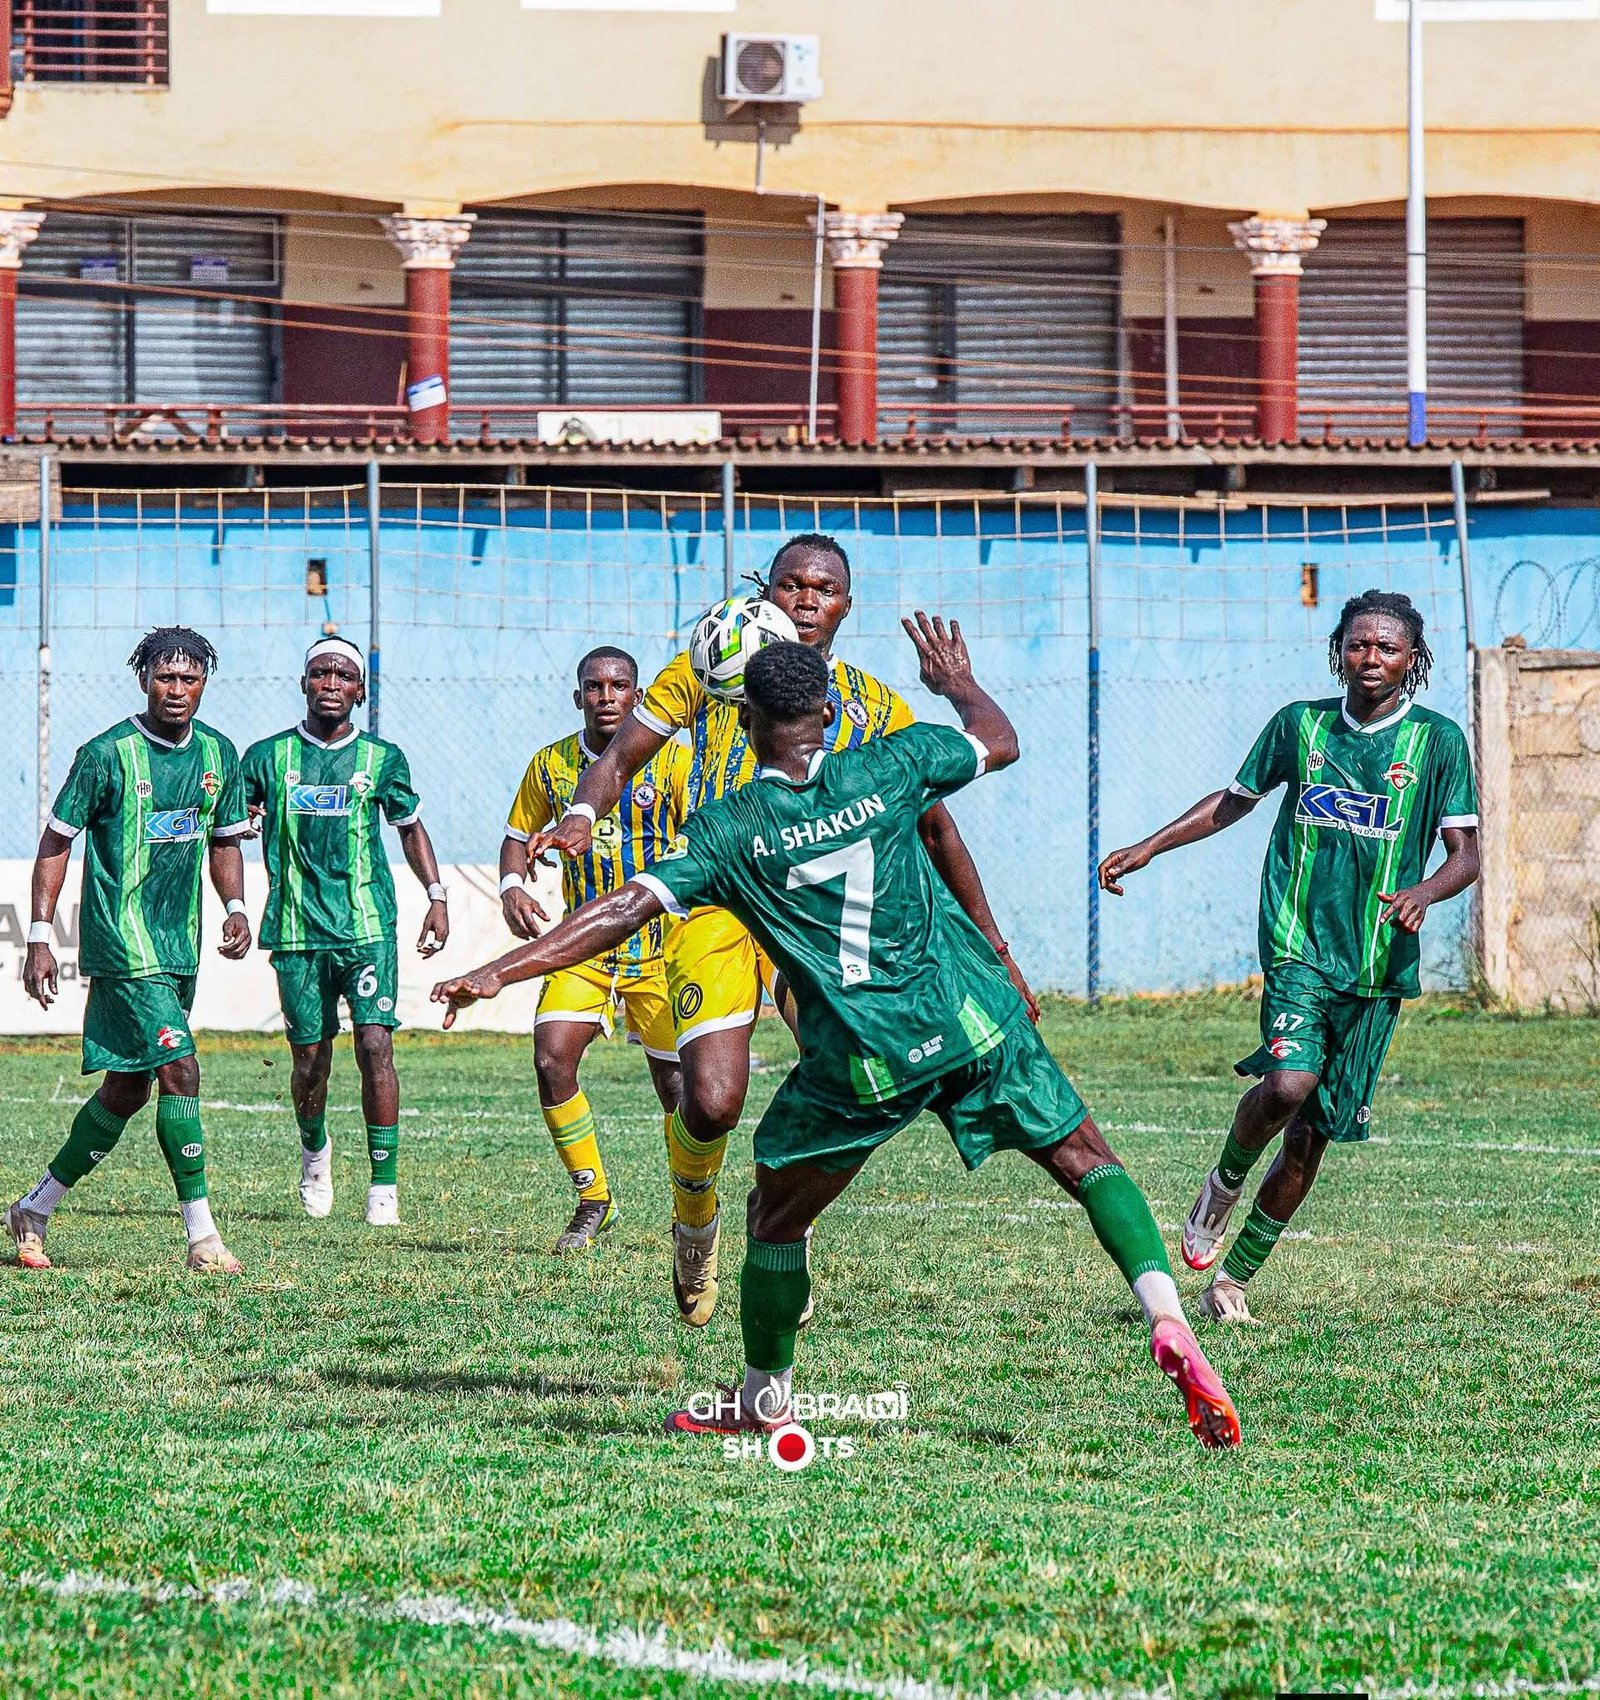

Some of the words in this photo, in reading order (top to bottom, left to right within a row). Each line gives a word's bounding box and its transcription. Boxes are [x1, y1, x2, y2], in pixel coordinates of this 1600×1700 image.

[753, 835, 776, 858] A.
[780, 794, 886, 851] SHAKUN
[786, 837, 875, 987] 7
[357, 965, 378, 997] 6
[1273, 1012, 1305, 1031] 47
